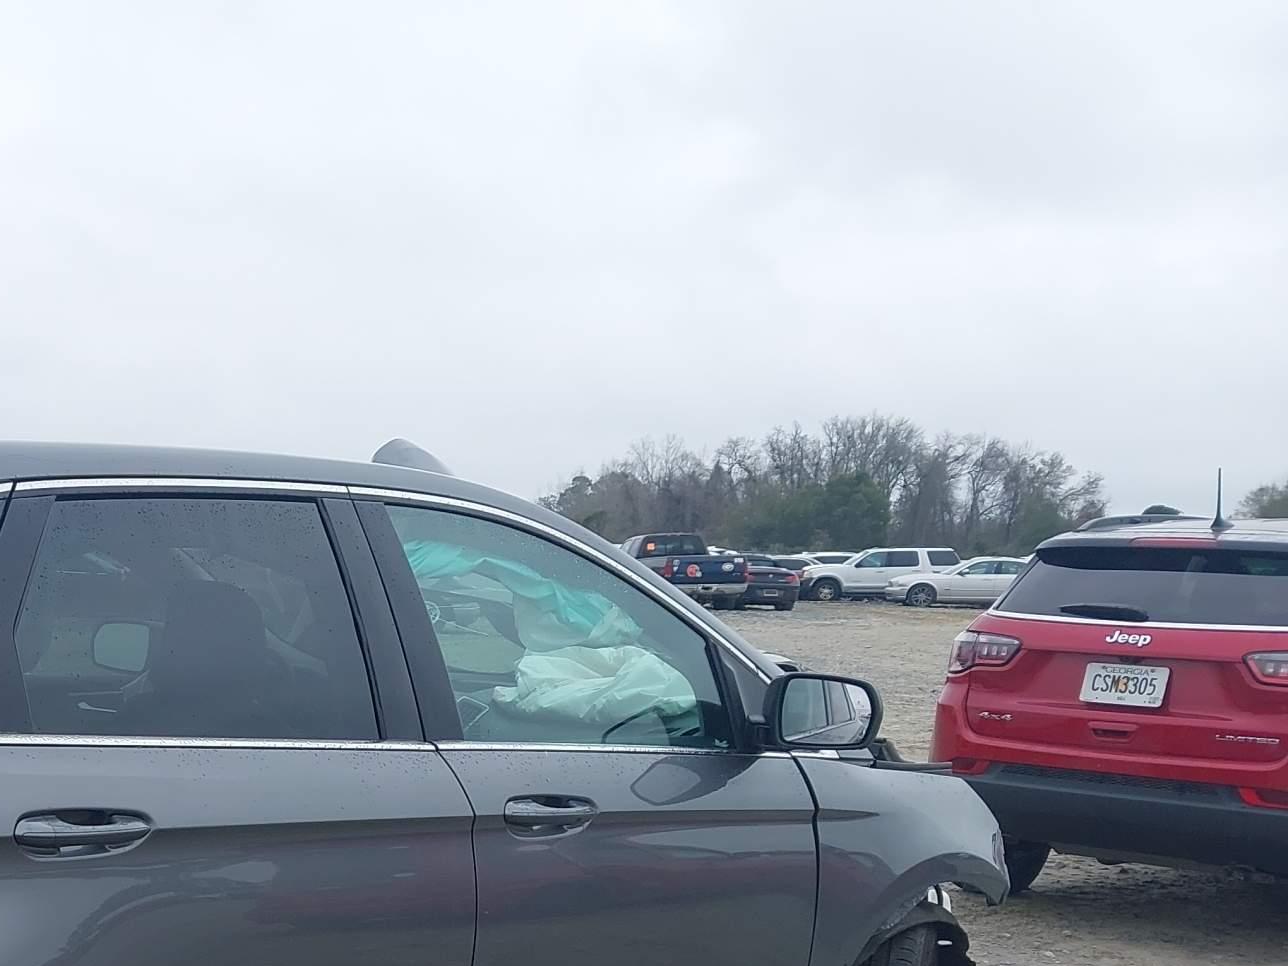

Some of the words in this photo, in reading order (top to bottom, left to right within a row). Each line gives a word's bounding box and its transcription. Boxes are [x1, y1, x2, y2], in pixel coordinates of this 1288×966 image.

[1105, 630, 1152, 647] Jeep
[1105, 666, 1150, 677] GEORGIA
[1091, 673, 1159, 696] CSM3305
